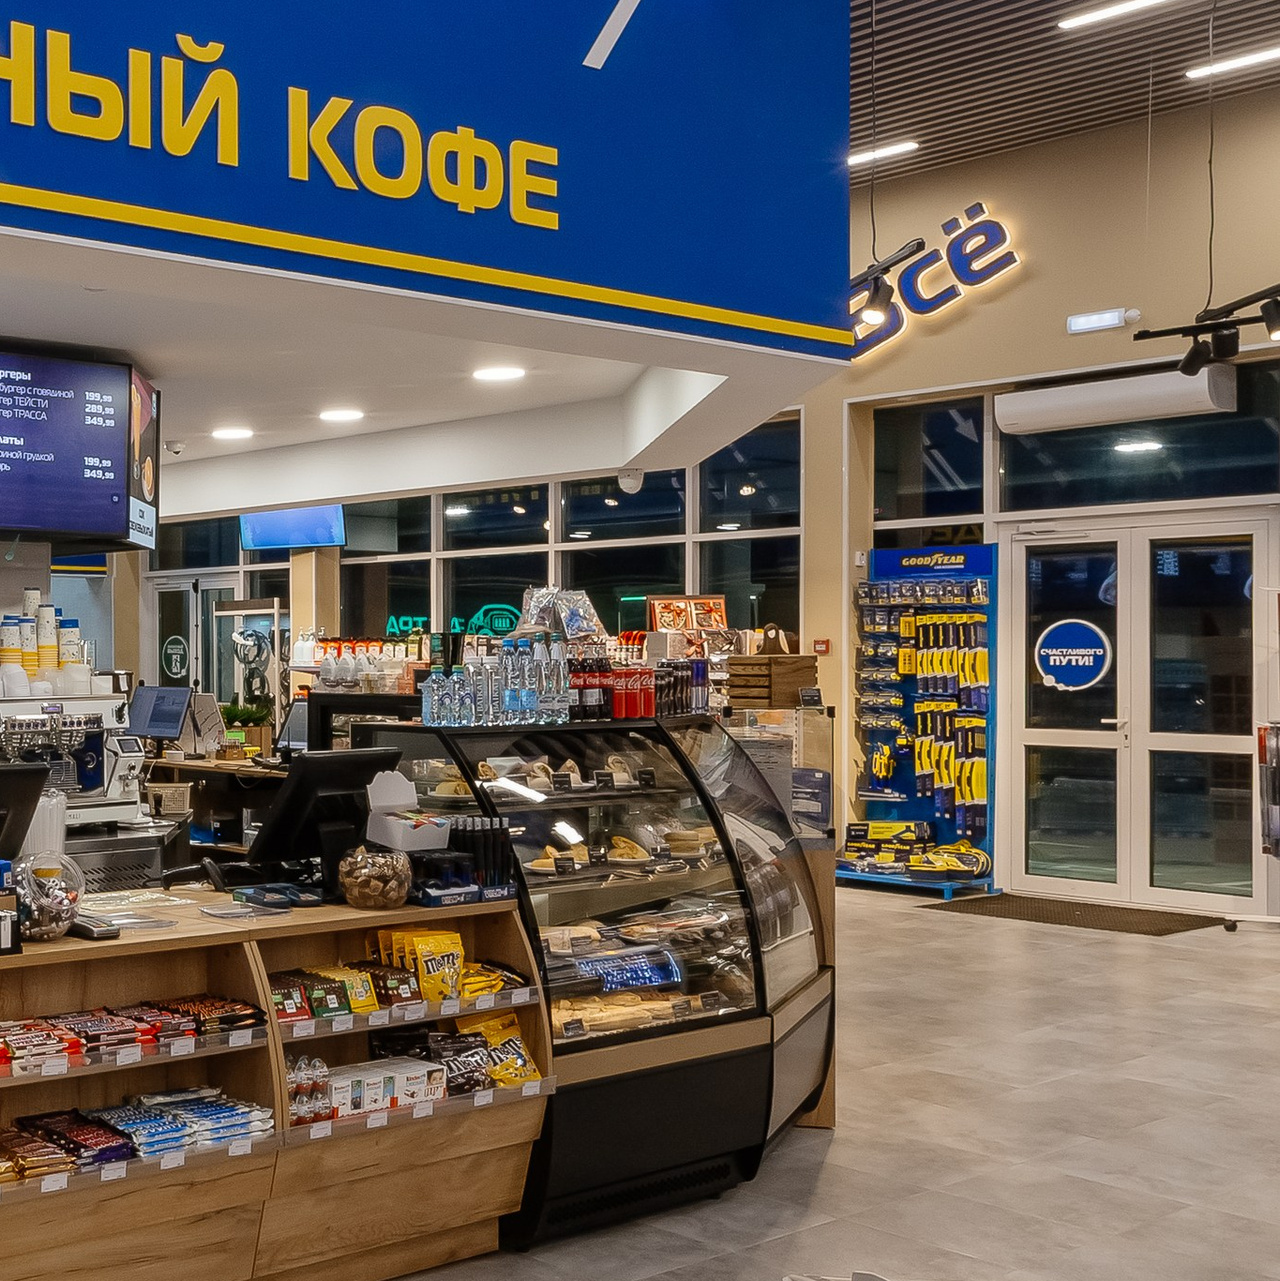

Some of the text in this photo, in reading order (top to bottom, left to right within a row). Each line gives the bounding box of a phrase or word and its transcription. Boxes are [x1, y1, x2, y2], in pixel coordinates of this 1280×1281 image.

[286, 94, 561, 232] КОФЕ
[33, 387, 74, 399] говядиной
[13, 396, 49, 408] ТЕЙСТИ
[13, 408, 48, 420] ТРАССА
[23, 452, 54, 462] грудкой
[902, 553, 965, 567] GOODYEAR
[1040, 648, 1104, 656] СЧАСТЛИВОГО
[1049, 655, 1094, 666] ПУТИ!
